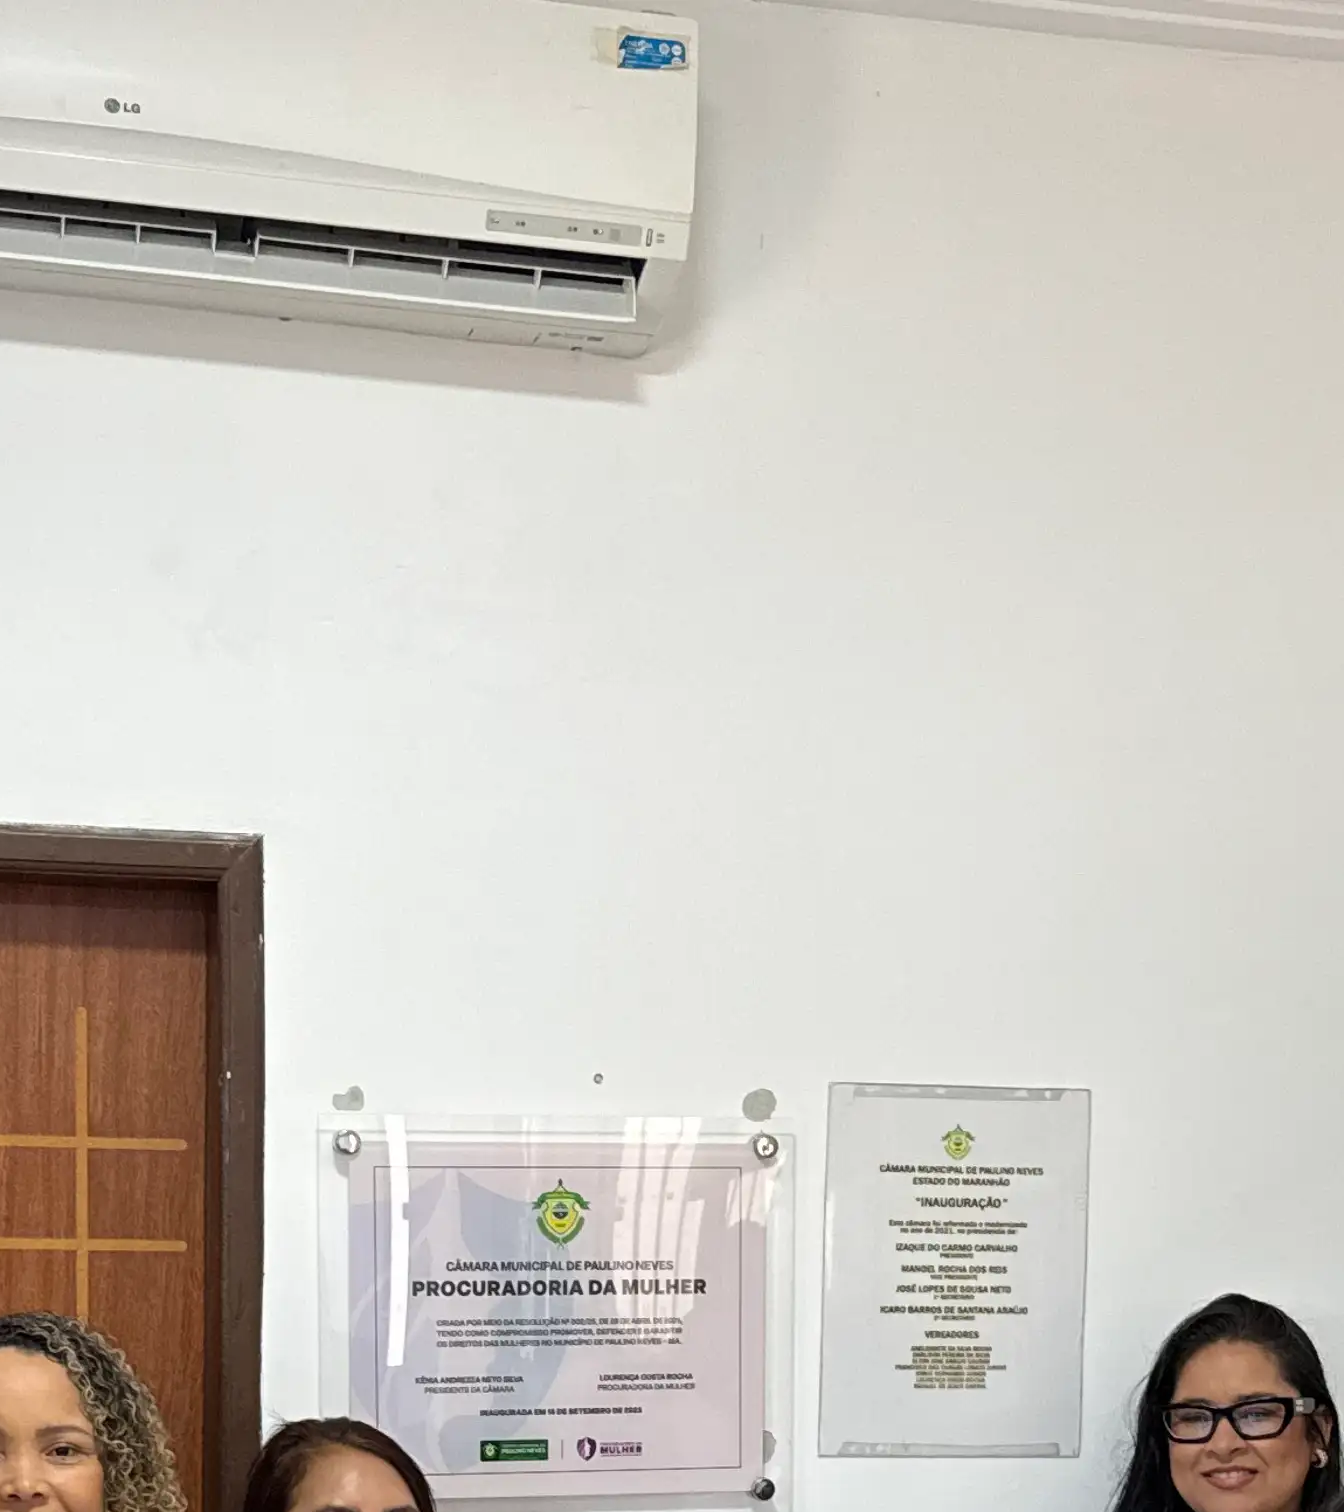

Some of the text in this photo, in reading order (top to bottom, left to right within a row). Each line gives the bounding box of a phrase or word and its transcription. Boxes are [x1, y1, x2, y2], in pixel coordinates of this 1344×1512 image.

[124, 102, 140, 114] LG
[446, 1258, 674, 1272] CÂMARA MUNICIPAL DE PAULINO NEVES
[412, 1278, 706, 1296] PROCURADORIA DA MULHER
[600, 1446, 642, 1454] MULHER
